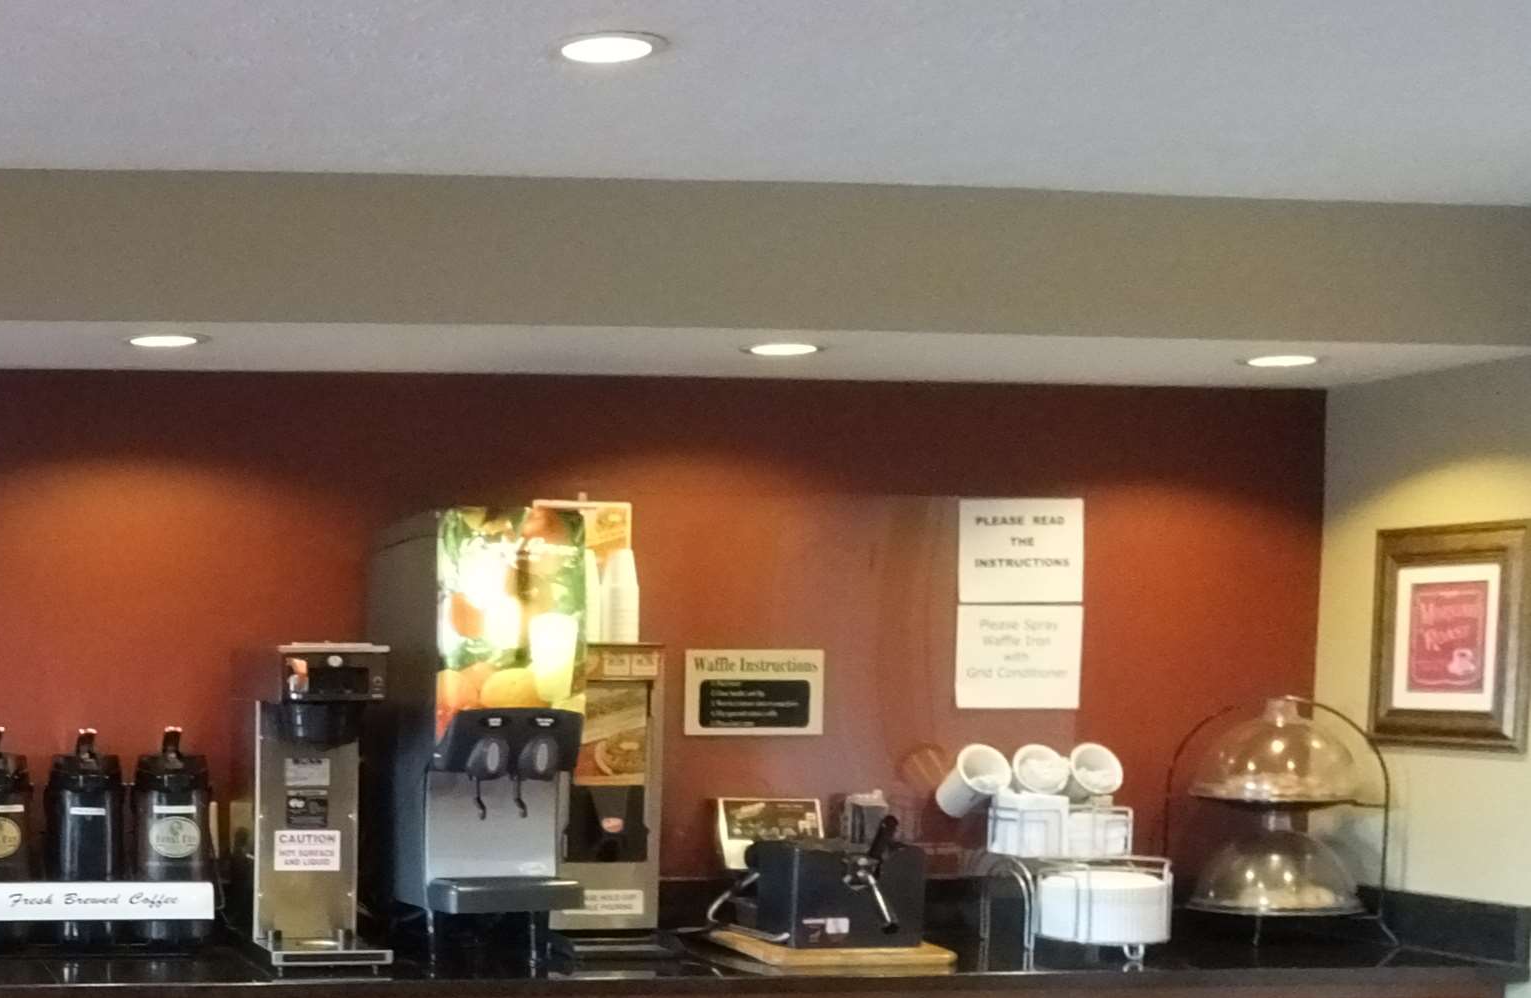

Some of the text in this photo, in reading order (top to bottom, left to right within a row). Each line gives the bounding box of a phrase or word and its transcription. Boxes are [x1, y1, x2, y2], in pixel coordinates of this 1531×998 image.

[975, 515, 1065, 526] PLEASE READ
[1010, 536, 1035, 546] THE
[974, 558, 1070, 568] INSTRUCTIONS
[979, 618, 1019, 631] Please
[693, 656, 818, 672] Waffle Instructions
[279, 833, 336, 844] CAUTION
[8, 891, 180, 909] Fresh Brewed Coffee
